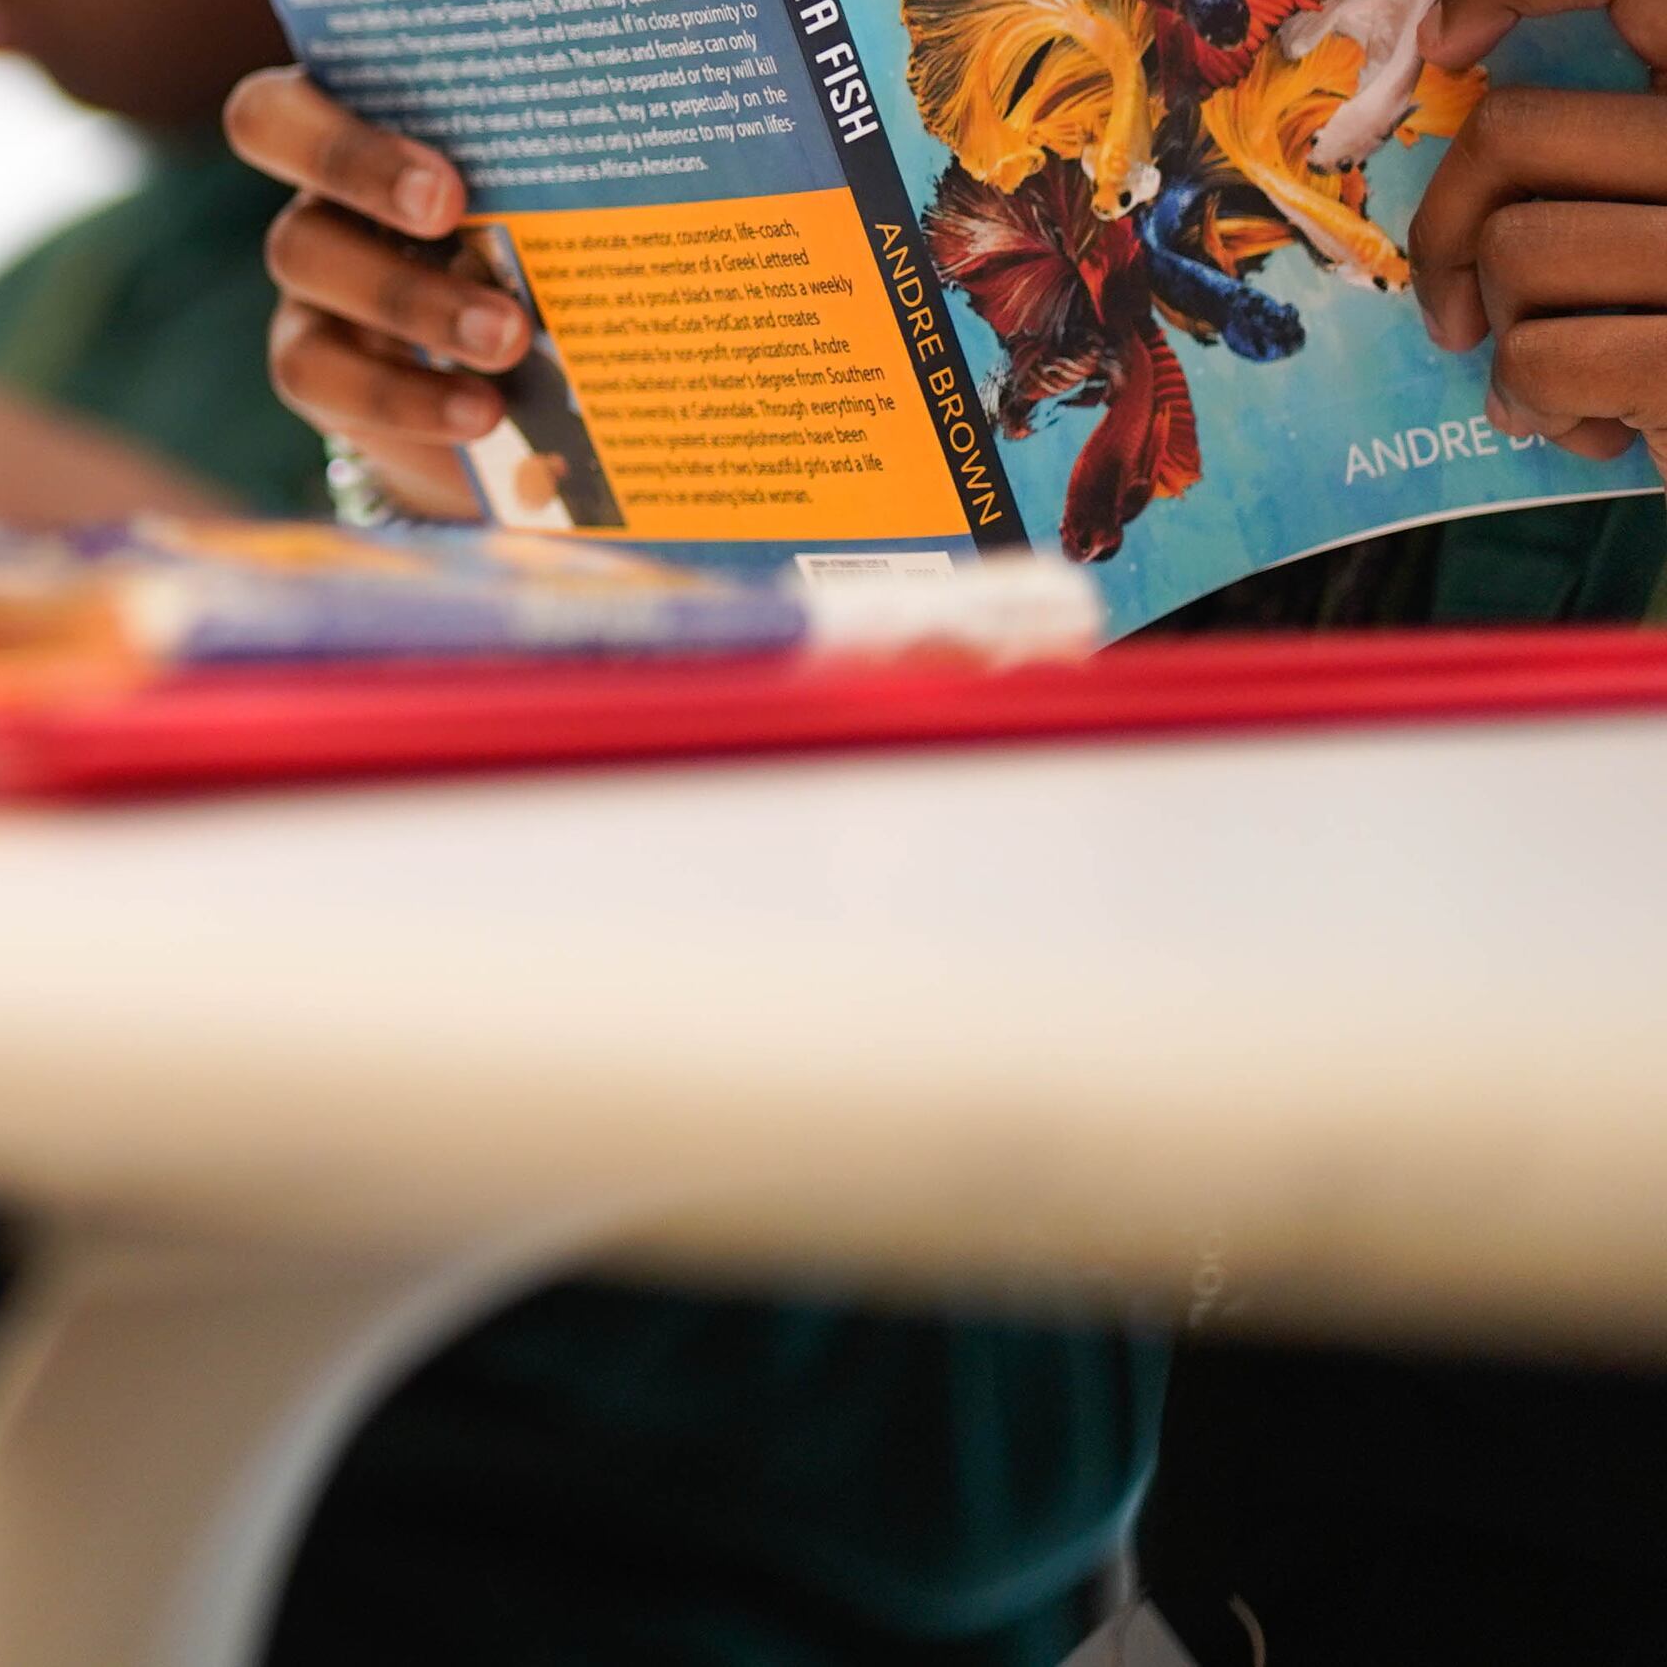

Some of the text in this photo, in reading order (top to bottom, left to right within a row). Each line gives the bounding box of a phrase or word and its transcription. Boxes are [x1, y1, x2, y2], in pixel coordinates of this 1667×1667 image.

[620, 13, 637, 34] If
[631, 13, 649, 32] in
[647, 10, 682, 31] close
[679, 3, 740, 31] proximity
[740, 1, 758, 19] to
[630, 40, 657, 62] and
[654, 36, 705, 59] females
[704, 37, 729, 53] can
[728, 29, 758, 53] only
[625, 65, 688, 93] separated
[686, 69, 702, 85] or
[701, 63, 732, 85] they
[730, 57, 757, 79] will
[754, 55, 778, 76] kill
[670, 89, 740, 120] perpetually
[742, 92, 762, 108] on
[762, 85, 788, 105] the
[815, 42, 879, 144] FISH
[697, 124, 716, 142] to
[713, 123, 736, 143] my
[736, 121, 766, 138] own
[762, 113, 796, 135] lifes-
[734, 218, 800, 240] life-coach,
[721, 252, 760, 272] Greek
[756, 246, 810, 269] Lettered
[743, 283, 764, 301] He
[761, 281, 798, 299] hosts
[798, 282, 808, 296] a
[808, 273, 853, 297] weekly
[776, 309, 821, 328] creates
[812, 335, 851, 355] Andre
[795, 367, 828, 386] from
[825, 365, 886, 385] Southern
[875, 223, 1003, 527] ANDRE BROWN
[810, 395, 877, 419] everything
[875, 393, 896, 411] he
[833, 425, 868, 444] been
[829, 455, 855, 474] and
[854, 459, 864, 473] a
[861, 453, 884, 472] life
[1344, 415, 1498, 485] ANDRE
